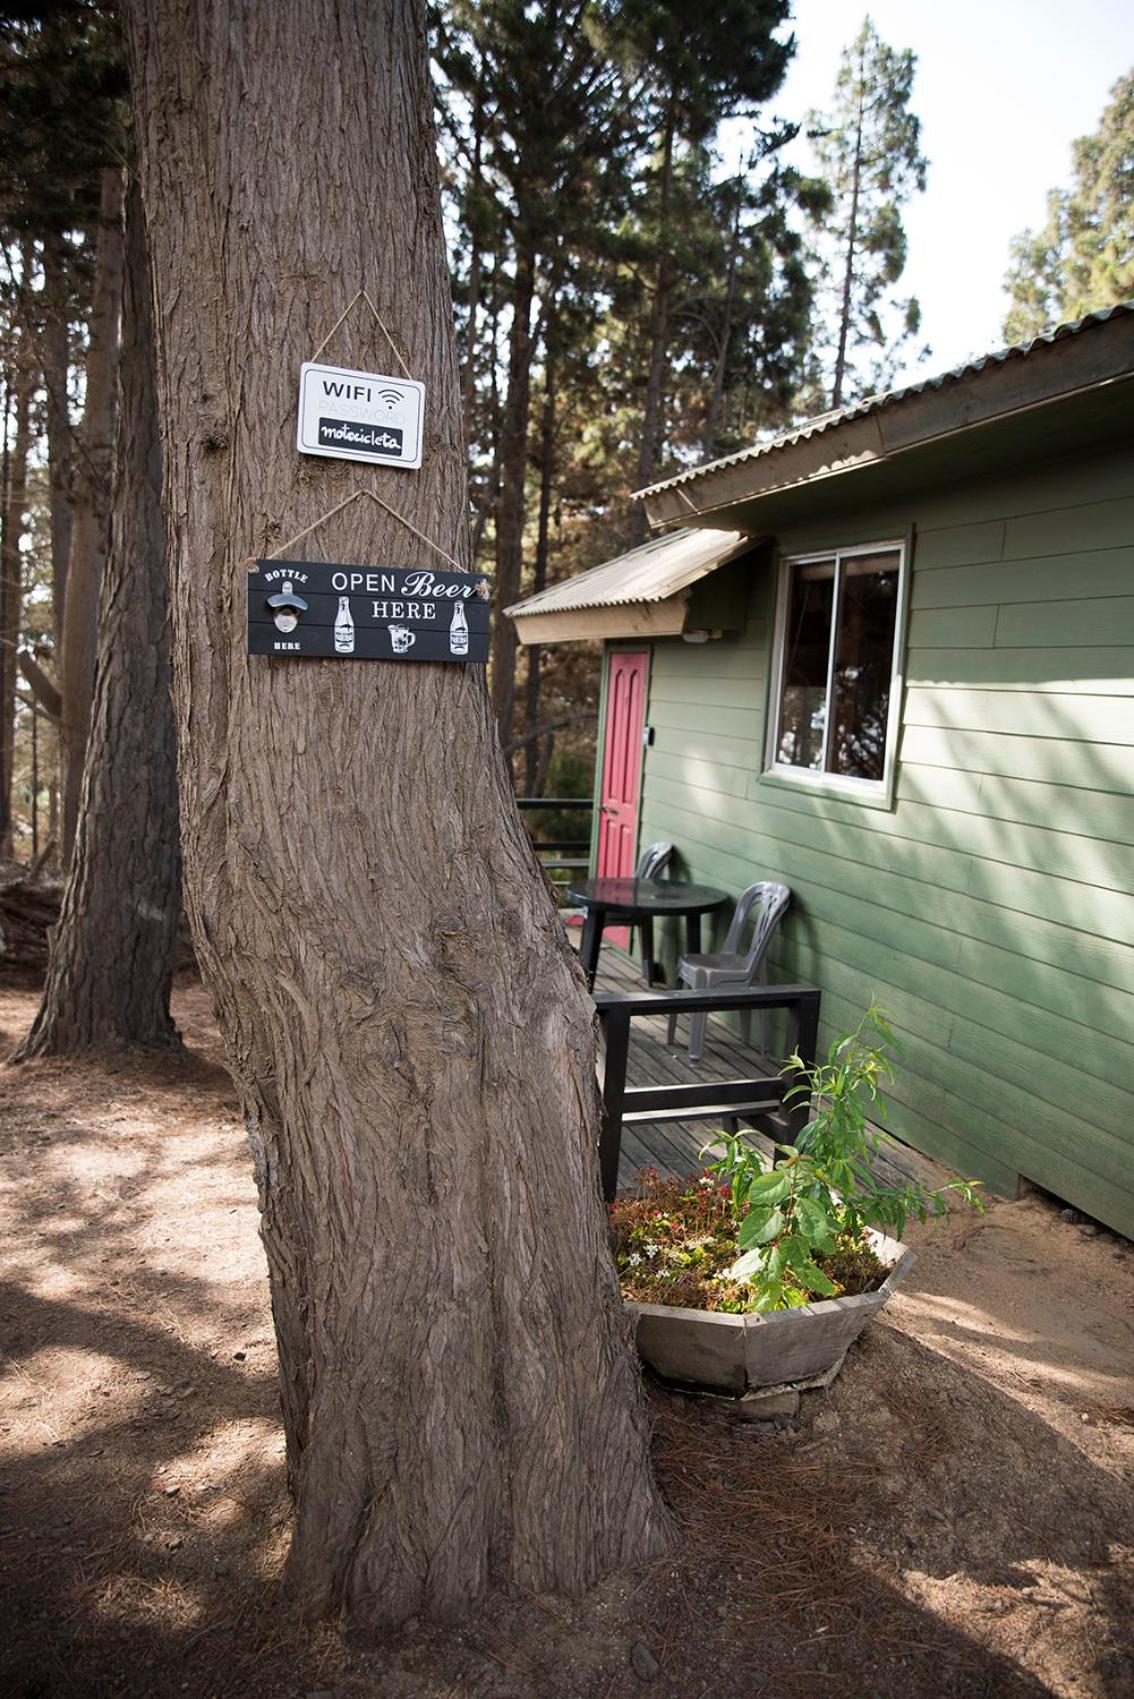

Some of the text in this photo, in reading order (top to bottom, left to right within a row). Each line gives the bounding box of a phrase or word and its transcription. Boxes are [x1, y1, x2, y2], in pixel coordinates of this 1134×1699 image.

[323, 380, 371, 402] WIFI
[264, 568, 308, 583] BOTTLE
[332, 571, 476, 598] OPEN Beer
[372, 601, 436, 619] HERE
[273, 642, 301, 650] HERE
